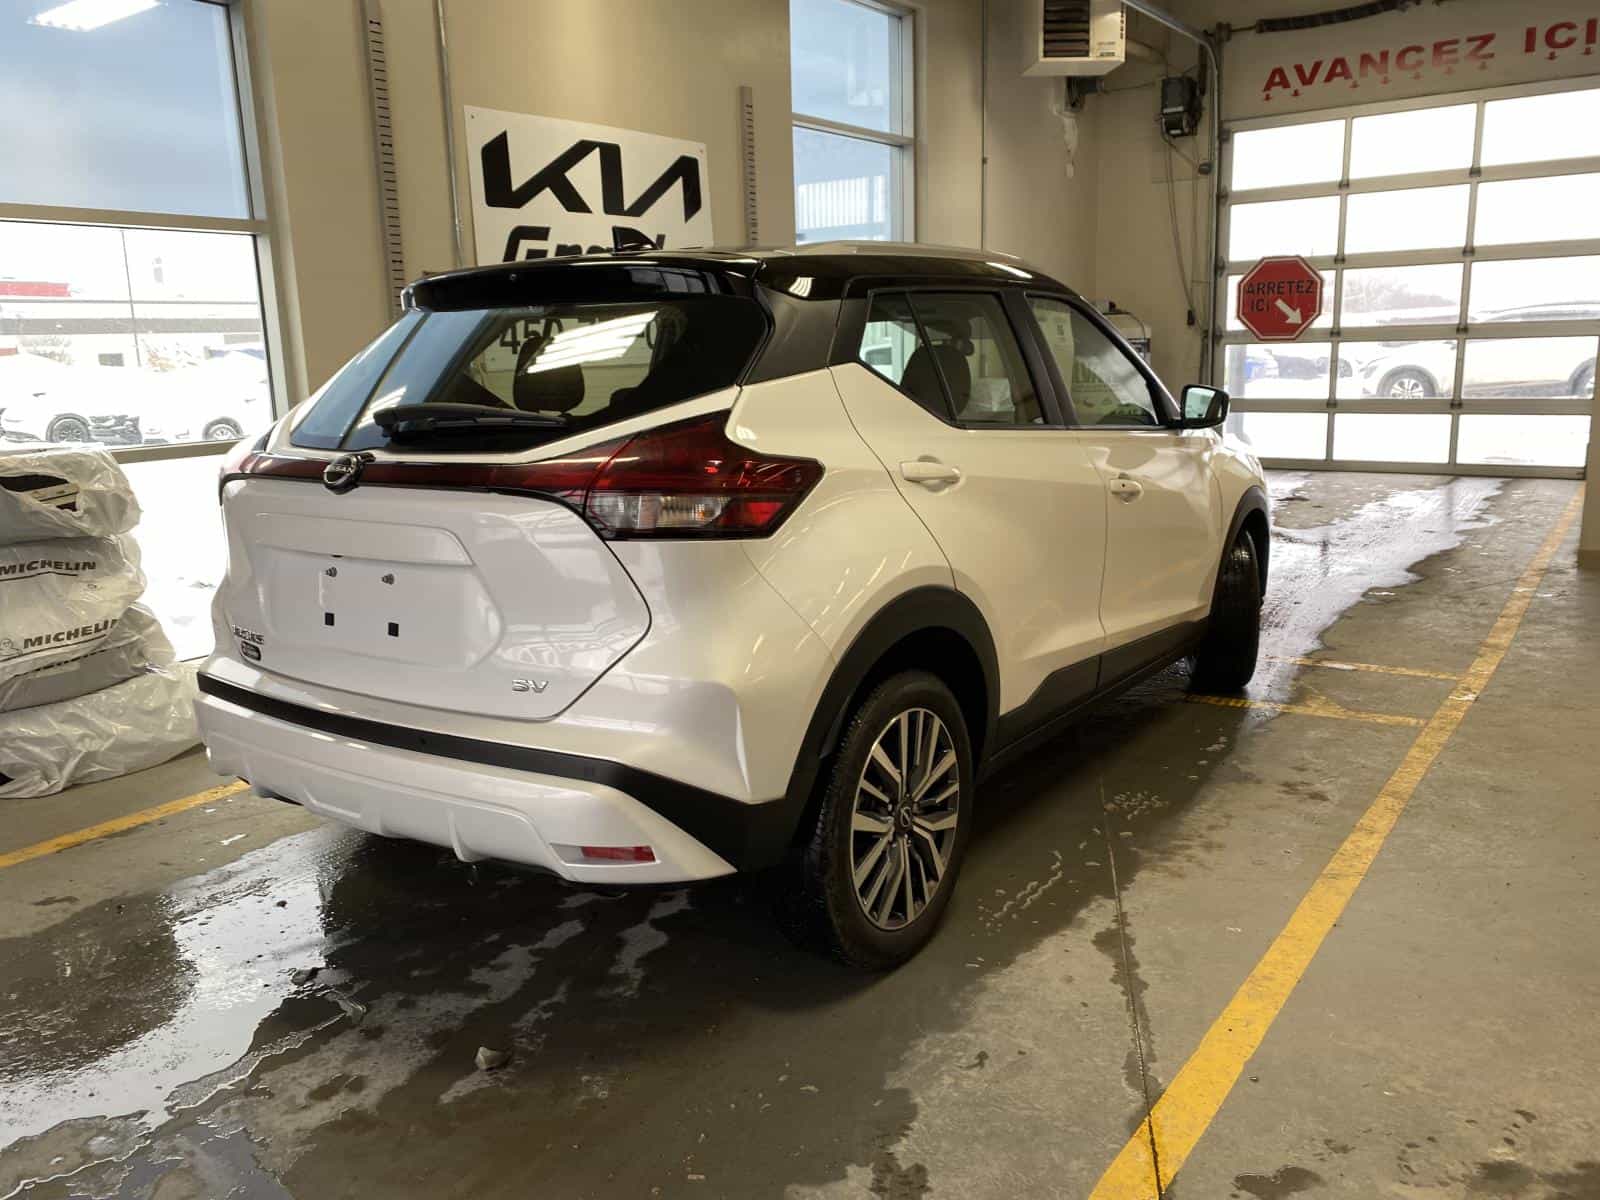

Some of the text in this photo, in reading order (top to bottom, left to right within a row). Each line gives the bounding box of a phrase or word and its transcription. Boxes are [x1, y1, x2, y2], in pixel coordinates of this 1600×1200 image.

[1262, 17, 1598, 92] AVANCEZ ICI
[481, 130, 702, 224] KIA
[1247, 280, 1314, 296] ARRETEZ
[1250, 299, 1271, 313] ICI
[0, 560, 97, 576] MICHELIN
[511, 679, 549, 694] SV
